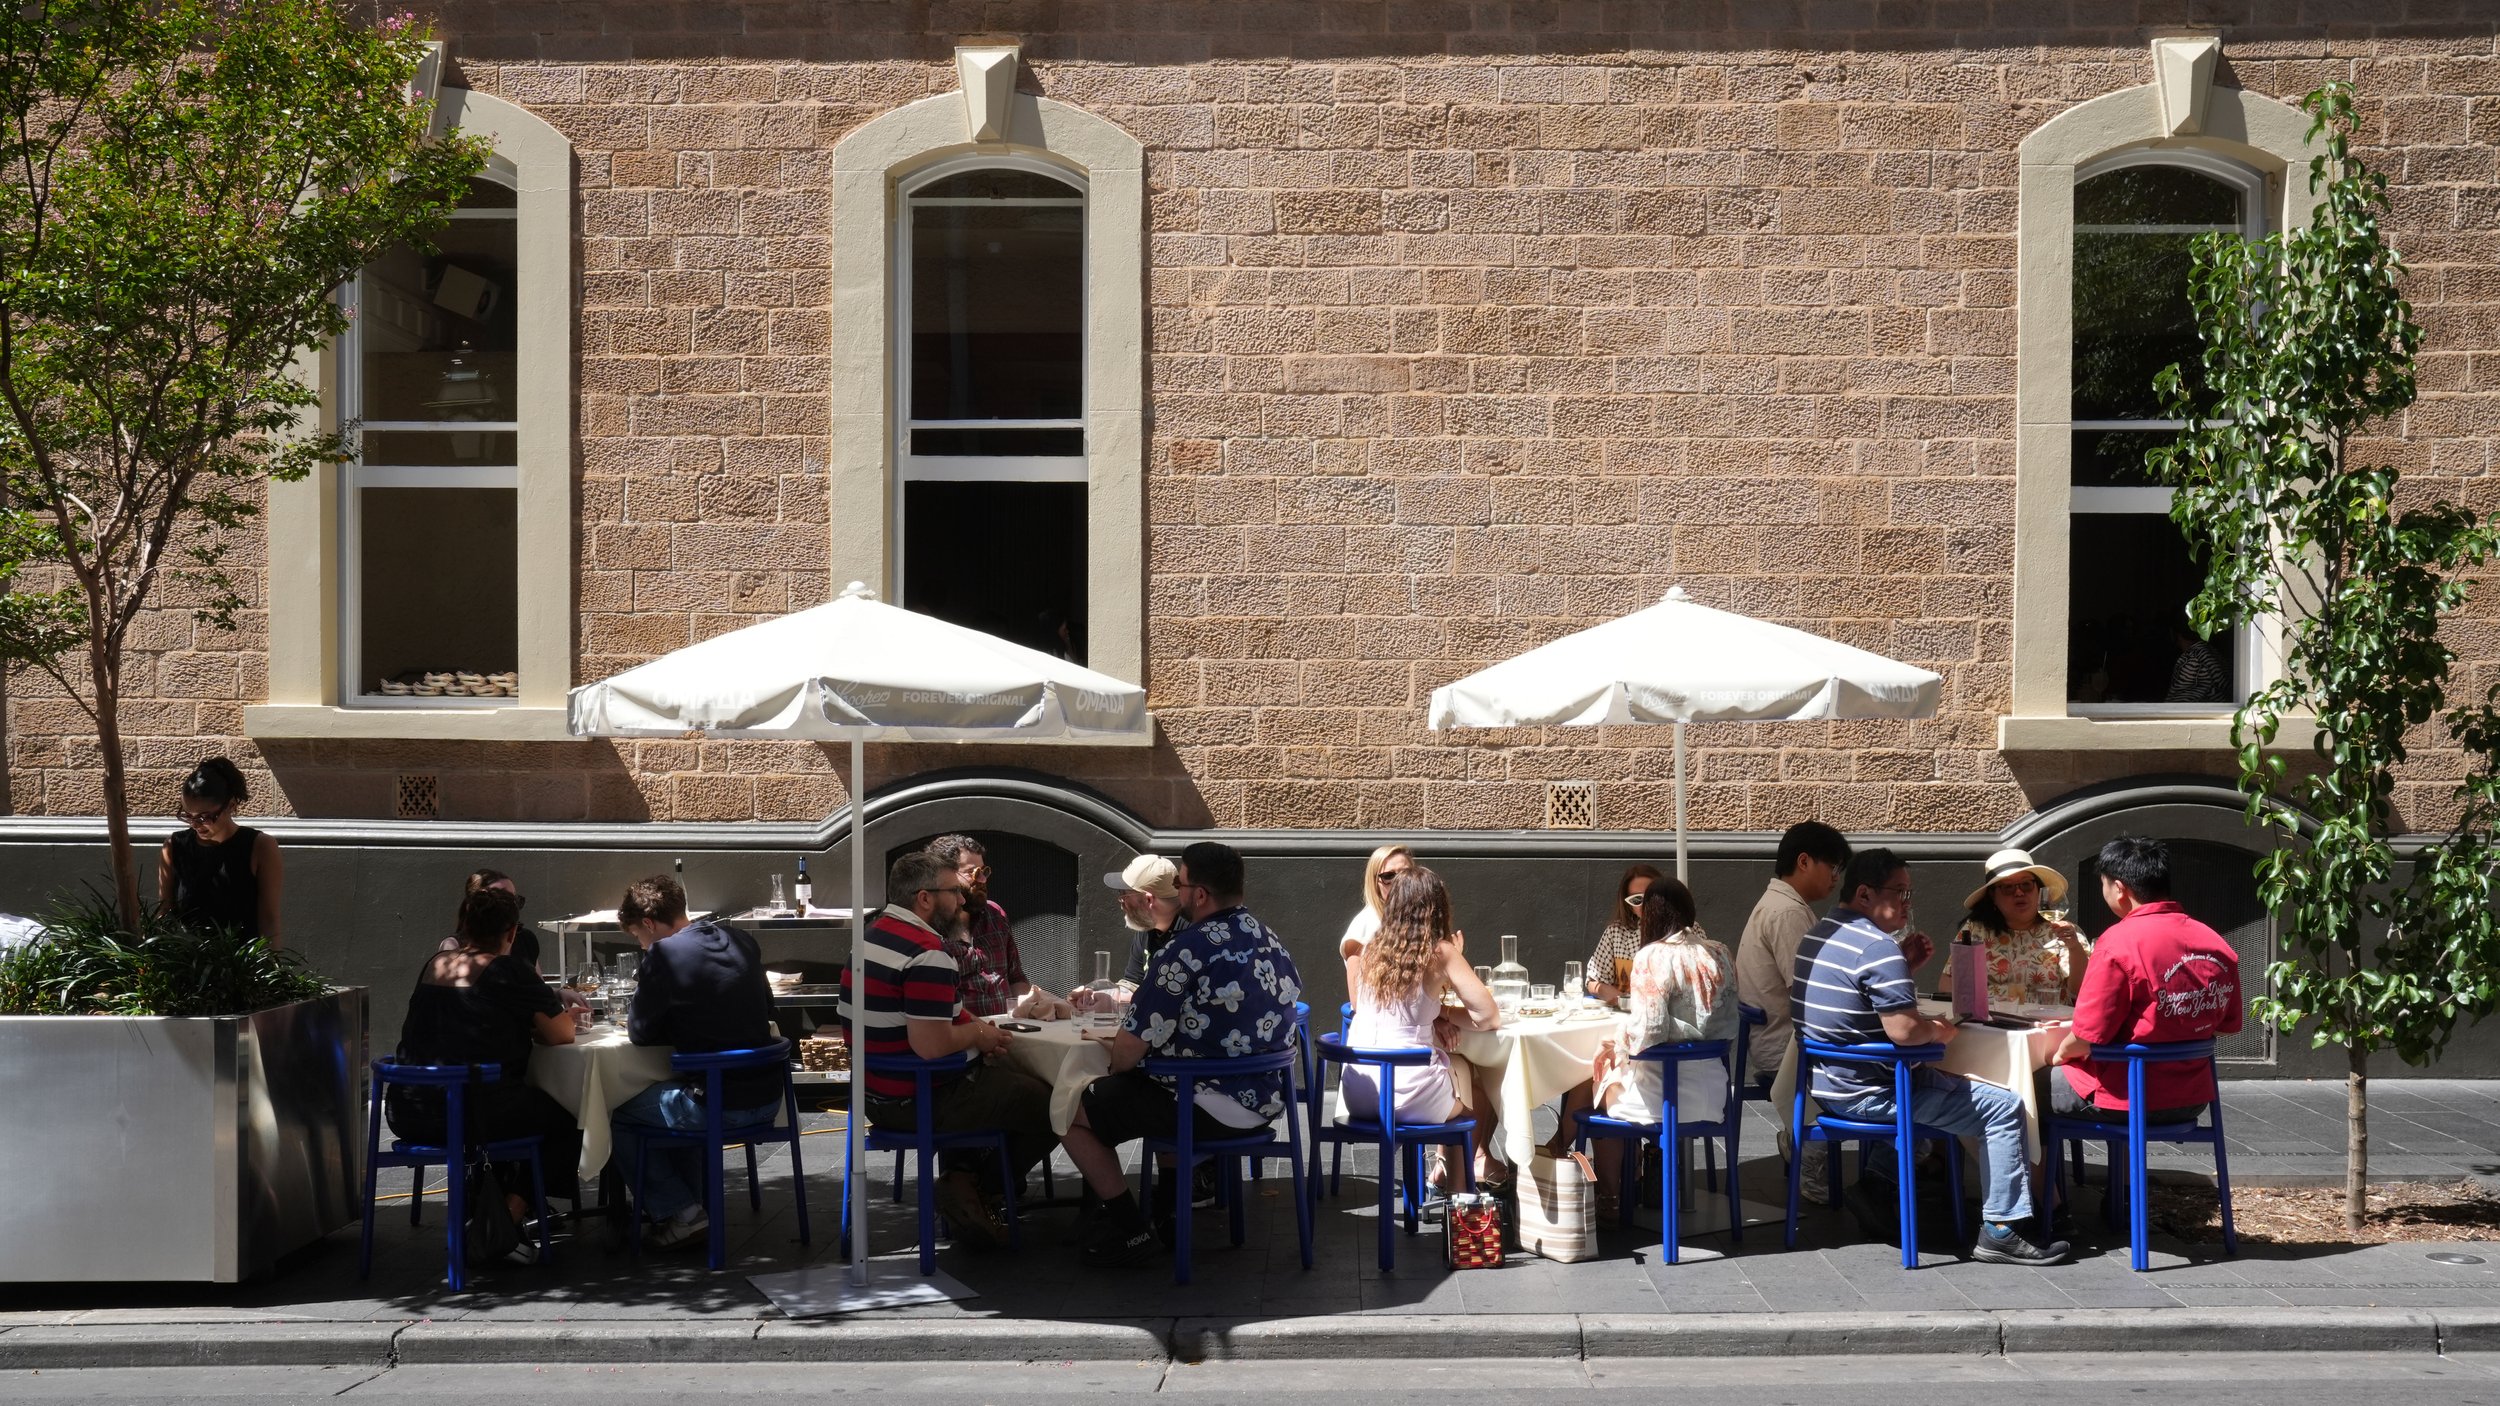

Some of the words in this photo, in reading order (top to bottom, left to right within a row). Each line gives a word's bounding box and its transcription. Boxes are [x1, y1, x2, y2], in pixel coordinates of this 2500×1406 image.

[836, 680, 892, 710] Coopers
[902, 691, 965, 705] FOREVER
[965, 692, 1027, 707] ORIGINAL
[1700, 690, 1756, 702] FOREVER
[2157, 986, 2207, 1011] Garment
[2164, 1000, 2192, 1018] New
[2192, 997, 2217, 1018] York
[1126, 1232, 1151, 1249] HOKA
